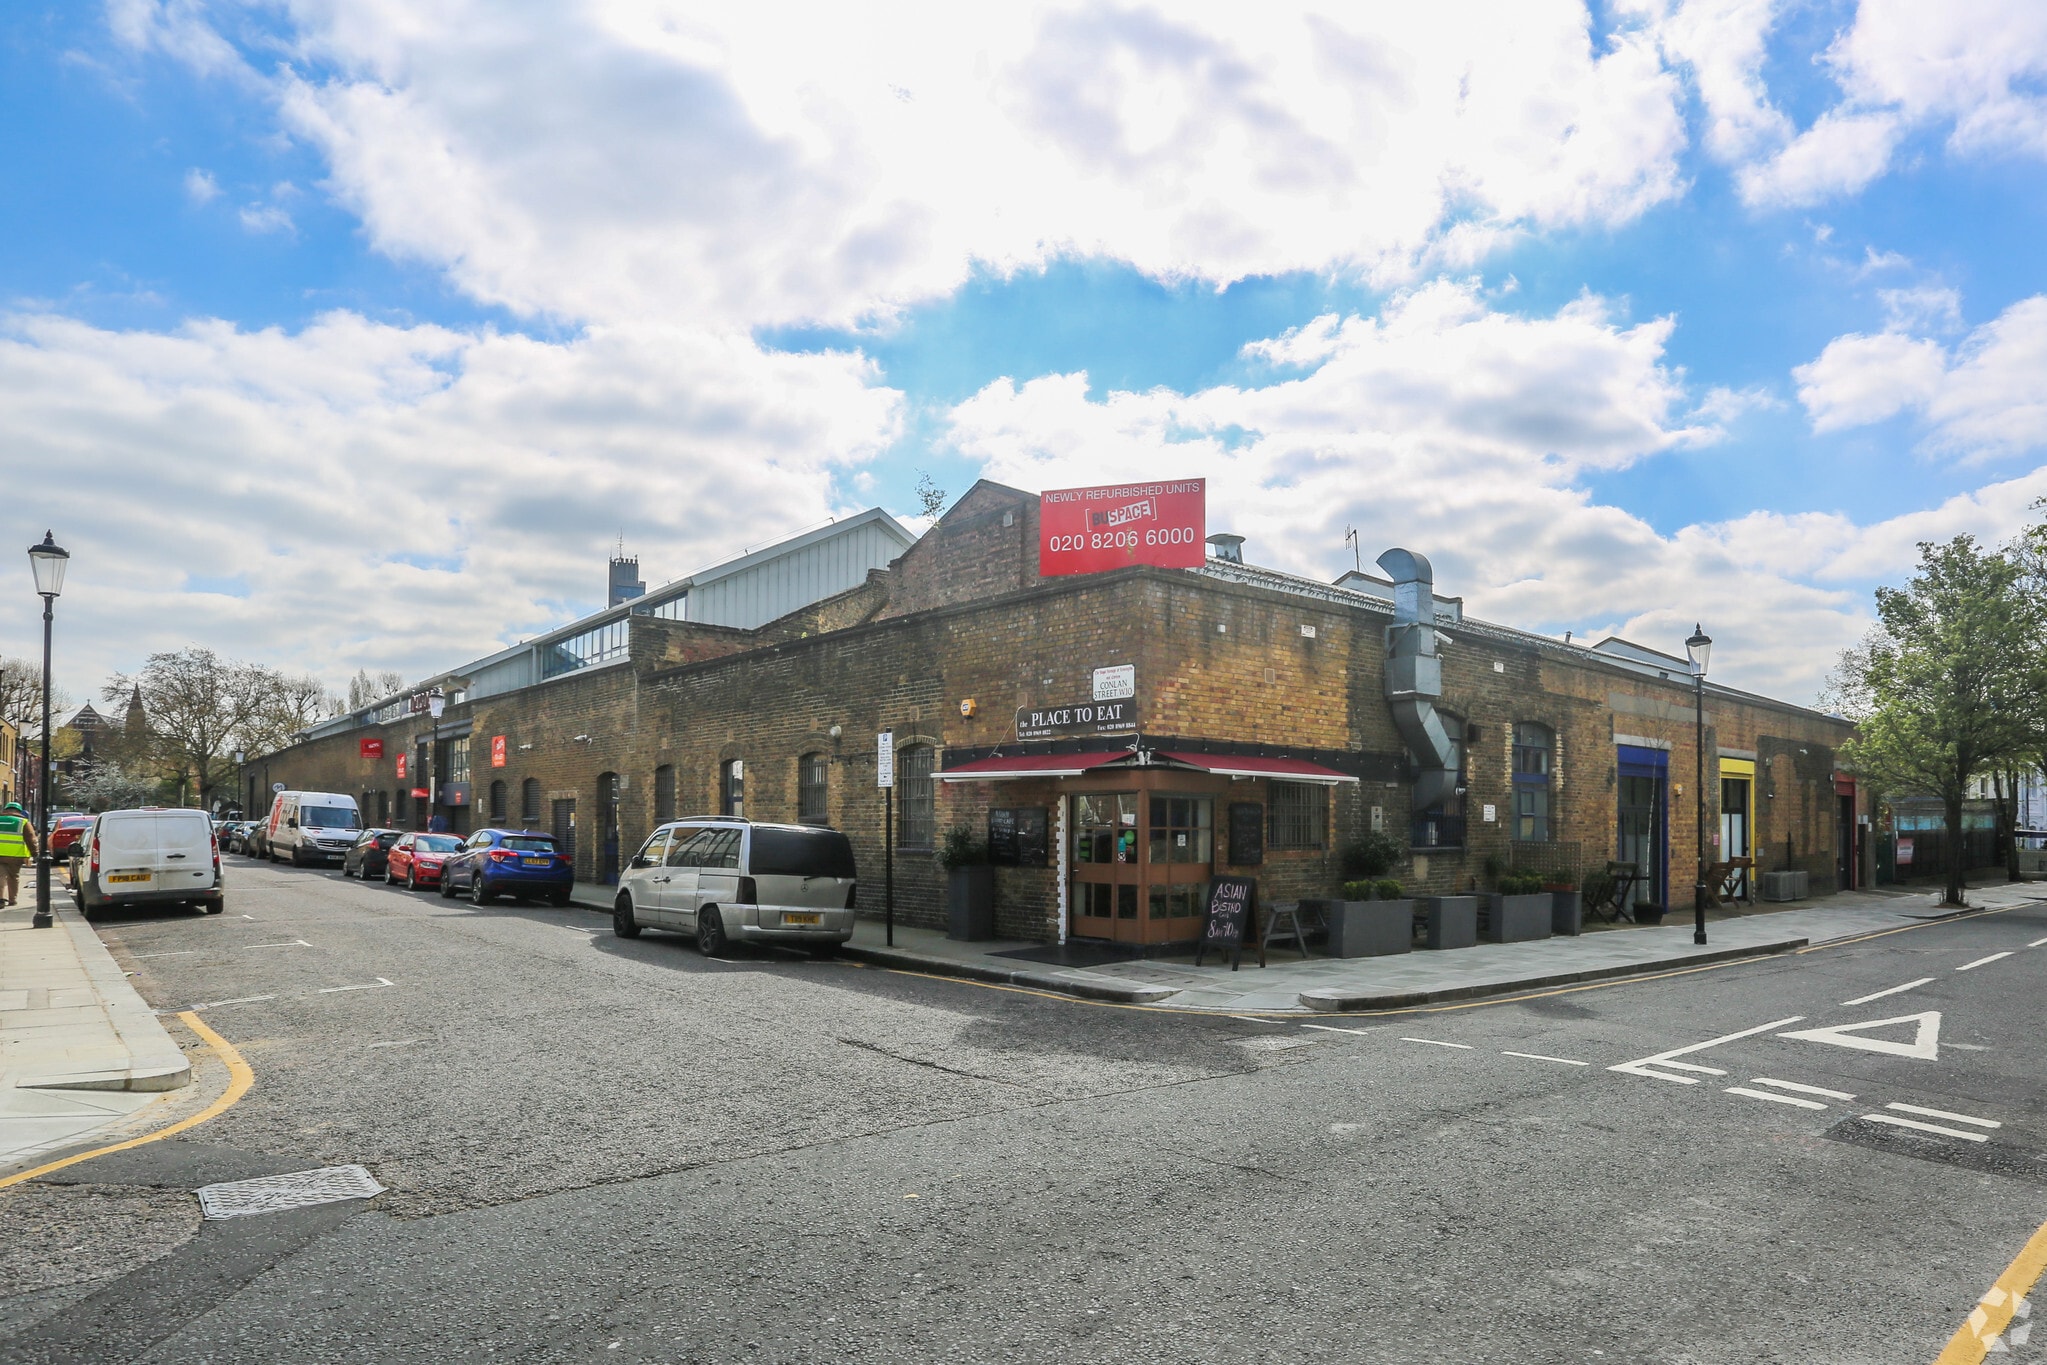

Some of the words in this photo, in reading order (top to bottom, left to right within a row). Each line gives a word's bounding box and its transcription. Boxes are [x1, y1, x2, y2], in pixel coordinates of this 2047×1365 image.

[1045, 491, 1083, 503] NEWLY
[1086, 485, 1163, 500] REFURBISHED
[1166, 482, 1200, 494] UNITS
[1050, 534, 1085, 552] 020
[1091, 530, 1139, 549] 8206
[1145, 527, 1195, 546] 6000
[1100, 679, 1127, 690] CONLAN
[1019, 720, 1028, 728] the
[1031, 709, 1071, 727] PLACE
[1074, 707, 1092, 723] TO
[1096, 704, 1123, 721] EAT
[1214, 883, 1248, 900] ASIAN
